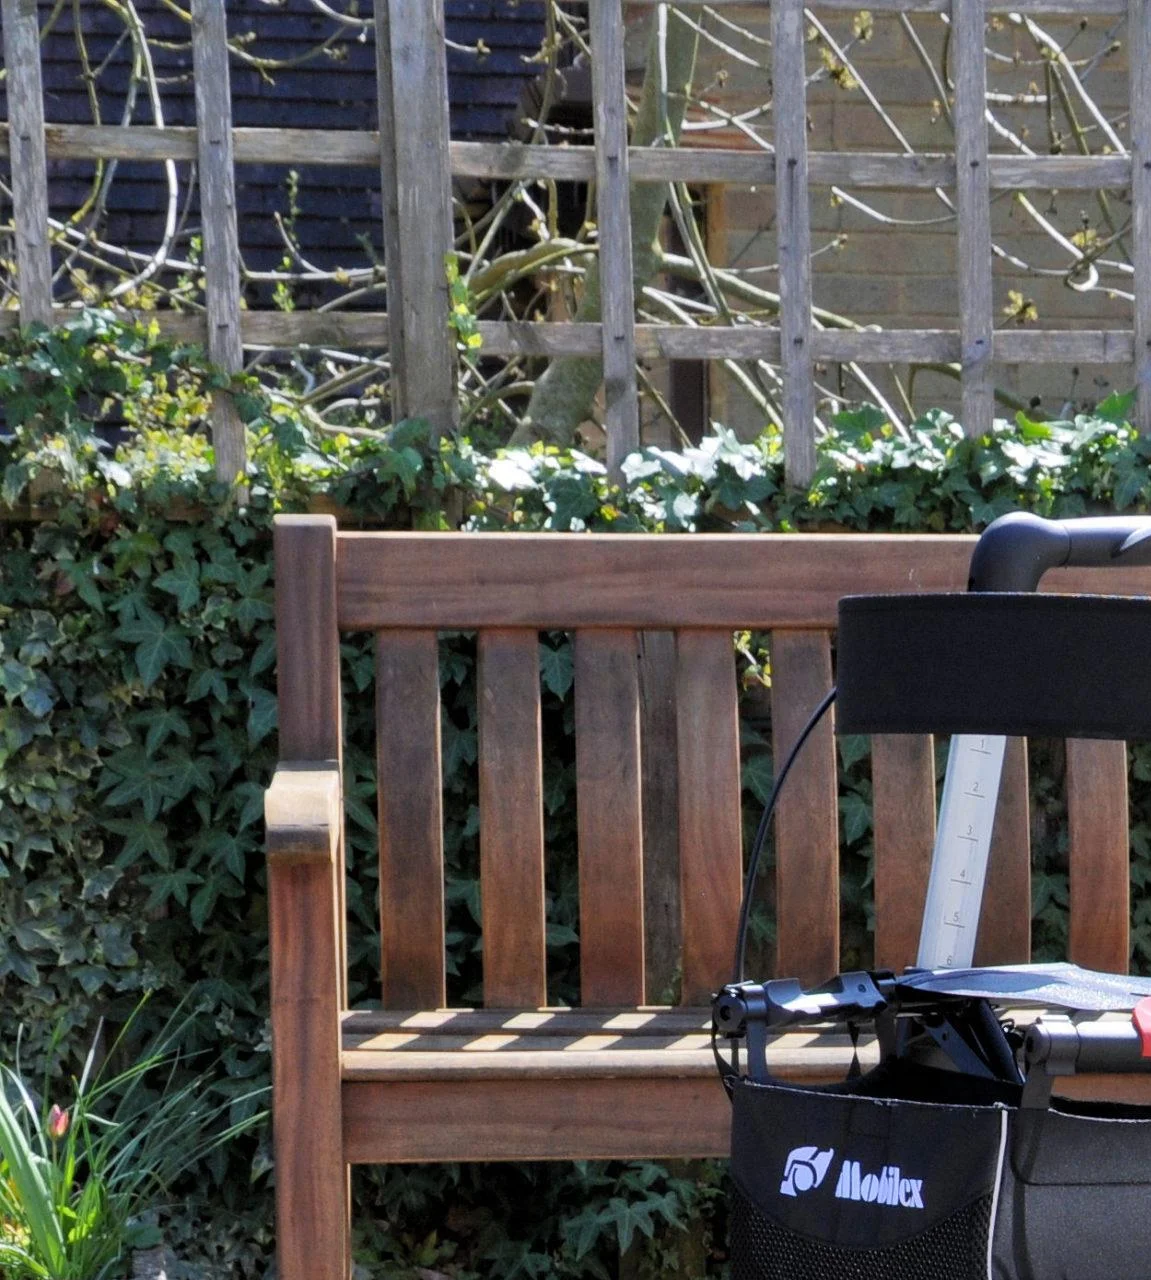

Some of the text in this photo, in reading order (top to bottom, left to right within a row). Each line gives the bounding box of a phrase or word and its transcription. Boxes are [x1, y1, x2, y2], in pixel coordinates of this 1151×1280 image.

[953, 911, 960, 922] 5
[946, 955, 953, 966] 6
[835, 1160, 924, 1209] Mobilex
